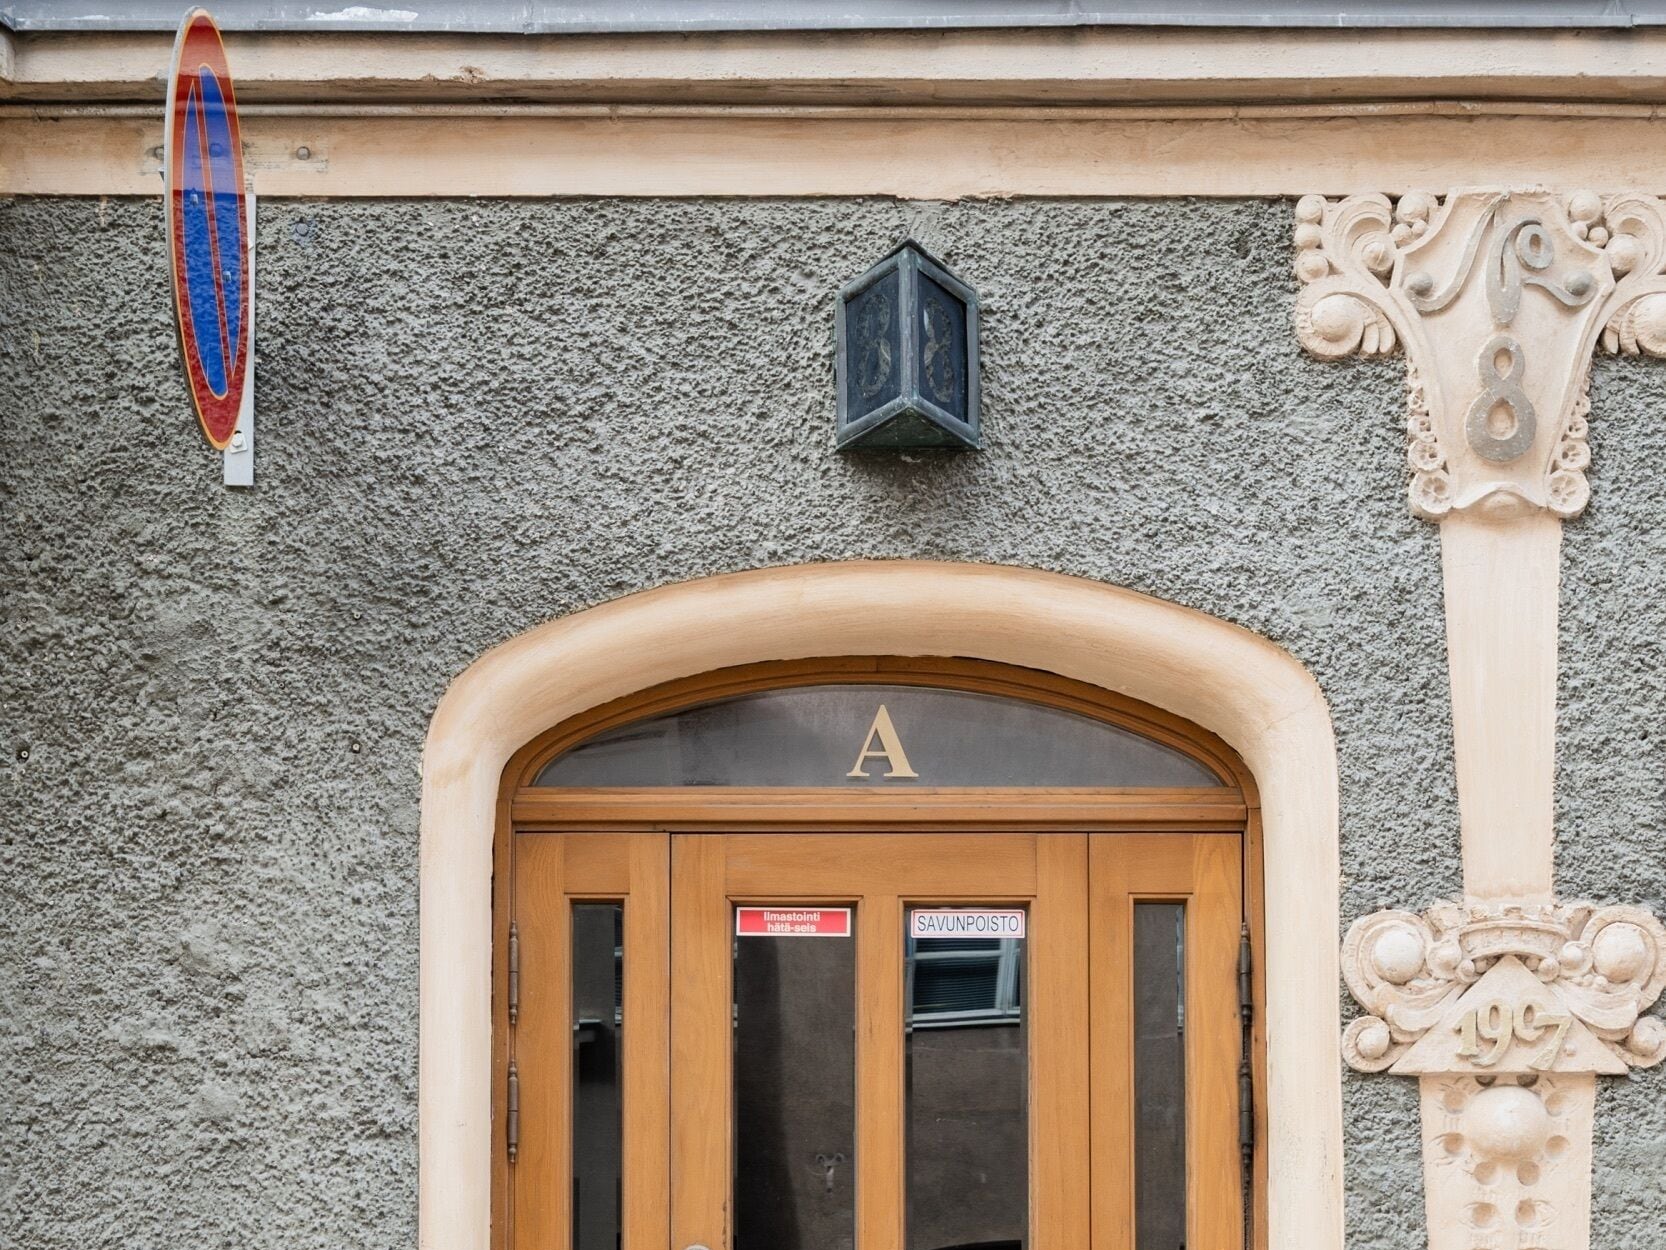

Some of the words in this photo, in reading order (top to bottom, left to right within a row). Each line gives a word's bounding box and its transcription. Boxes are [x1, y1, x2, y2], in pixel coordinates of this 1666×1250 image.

[1465, 335, 1537, 464] 8
[846, 704, 919, 777] A
[763, 911, 821, 922] Ilmastointi
[917, 915, 1019, 932] SAVUNPOISTO
[767, 922, 817, 933] hätä-seis
